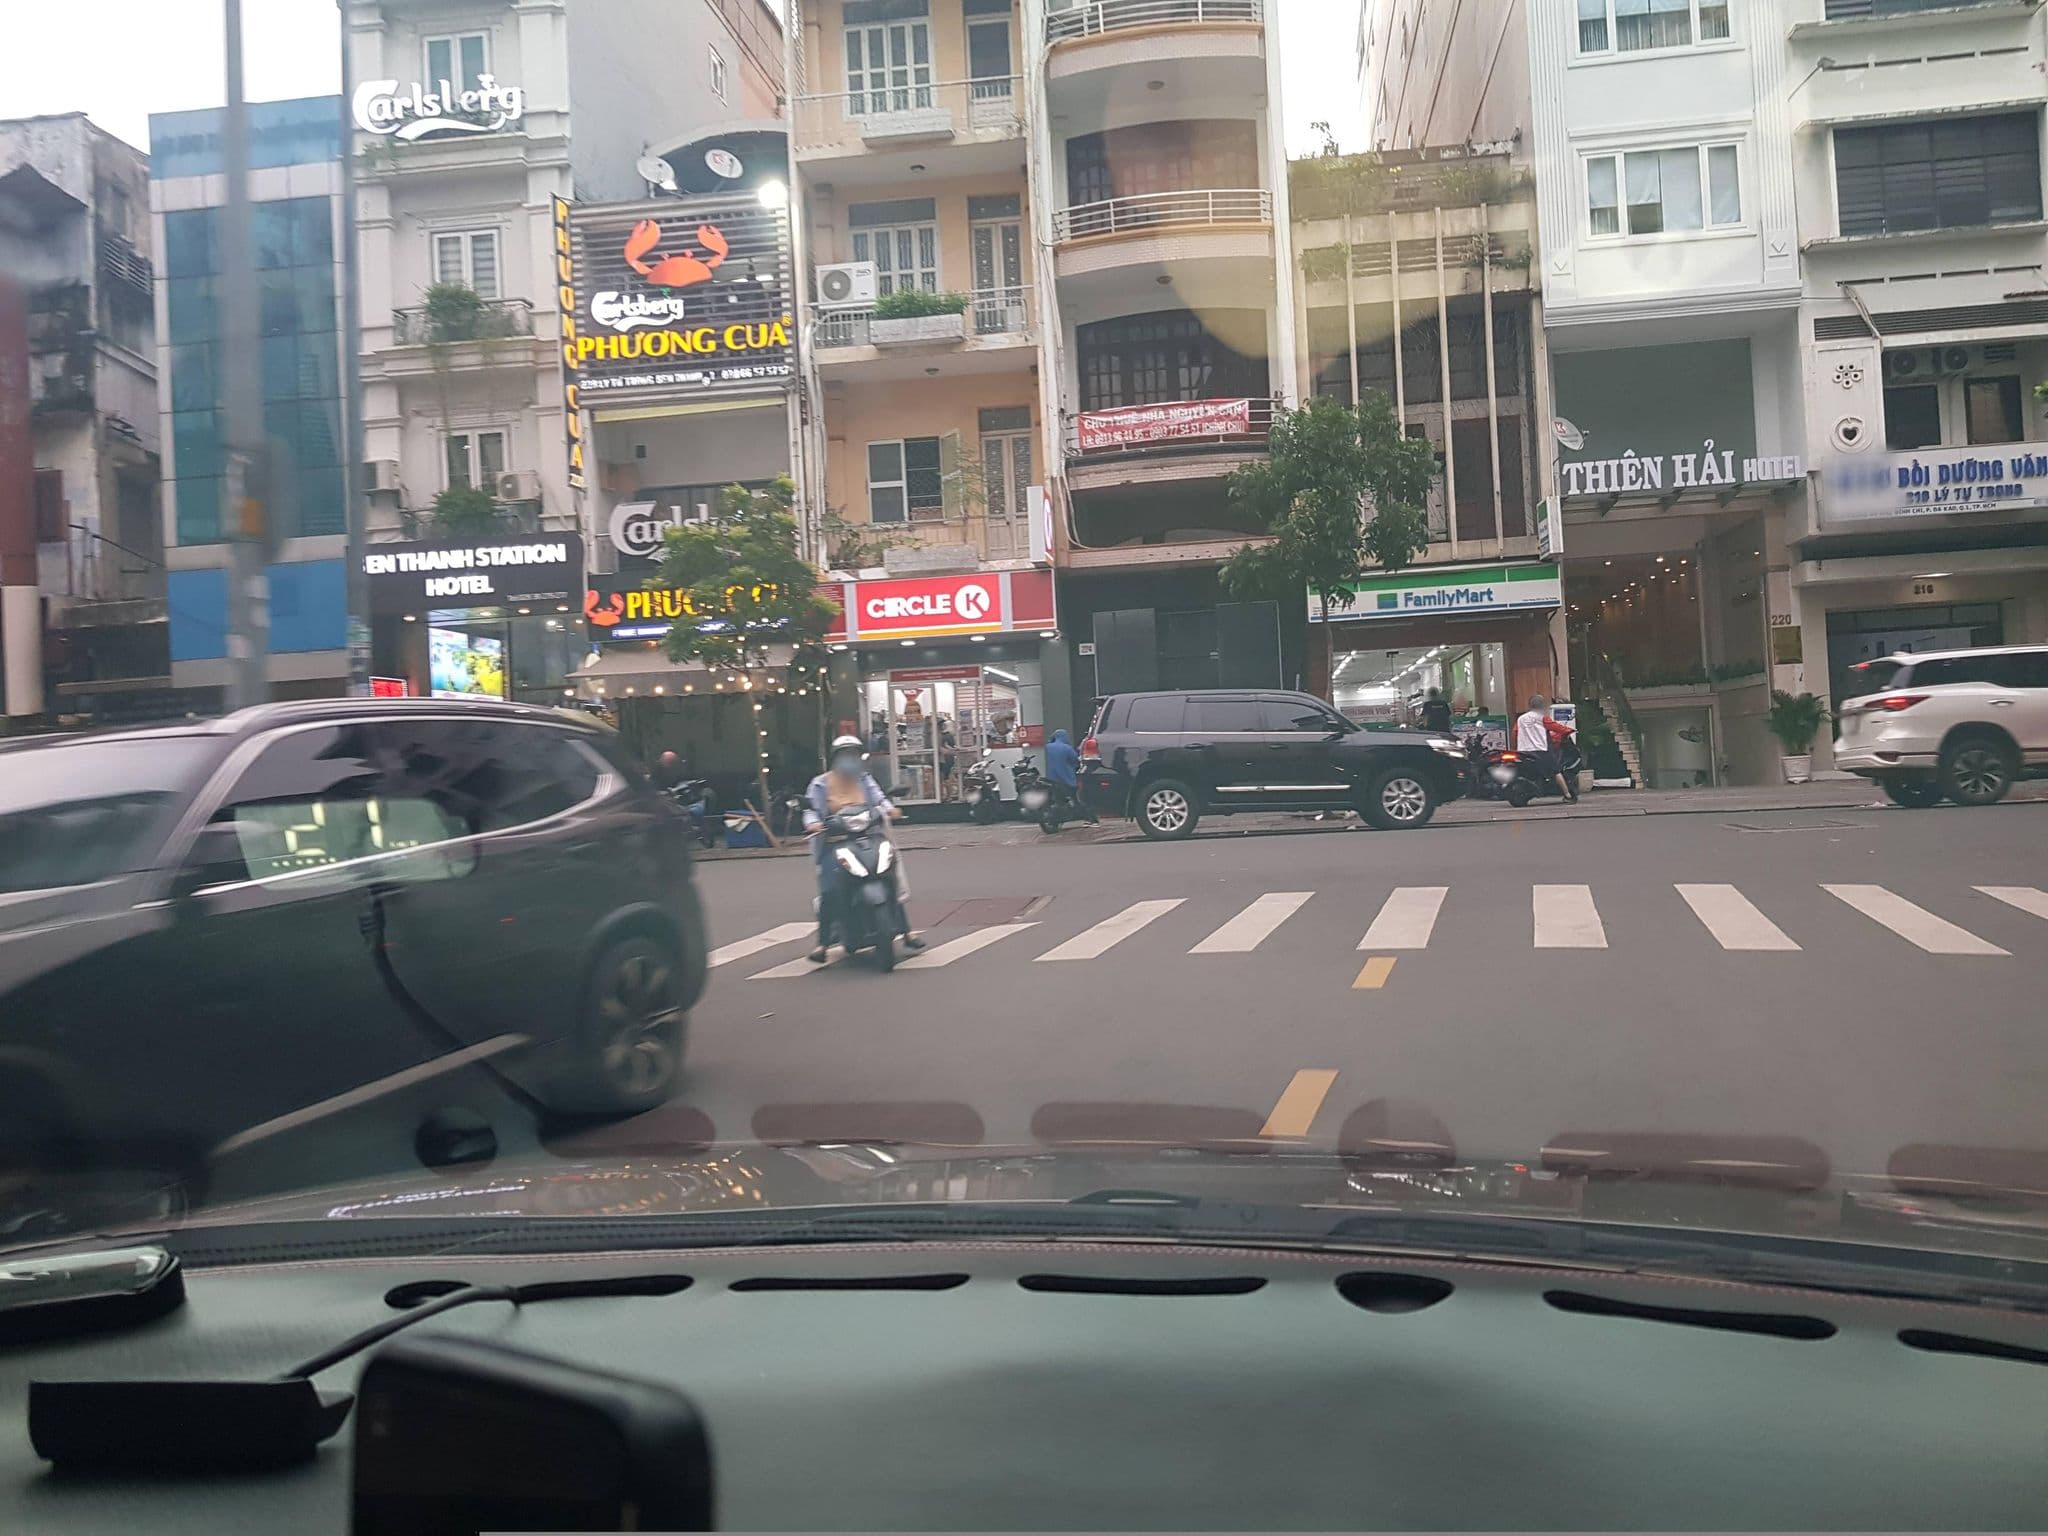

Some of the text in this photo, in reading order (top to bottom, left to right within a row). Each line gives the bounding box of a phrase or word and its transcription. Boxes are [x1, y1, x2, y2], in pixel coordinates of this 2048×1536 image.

[591, 290, 685, 331] Carlsberg
[576, 321, 788, 361] PHƯƠNG CUA
[1561, 448, 1663, 495] THIÊN
[1672, 438, 1736, 487] HẢI
[1742, 455, 1808, 482] HOTEL
[363, 554, 397, 574] EN
[475, 543, 567, 567] STATION
[425, 575, 495, 597] HOTEL
[1403, 587, 1494, 608] FamilyMart
[866, 587, 990, 619] CIRCLE K
[1771, 614, 1792, 626] 220
